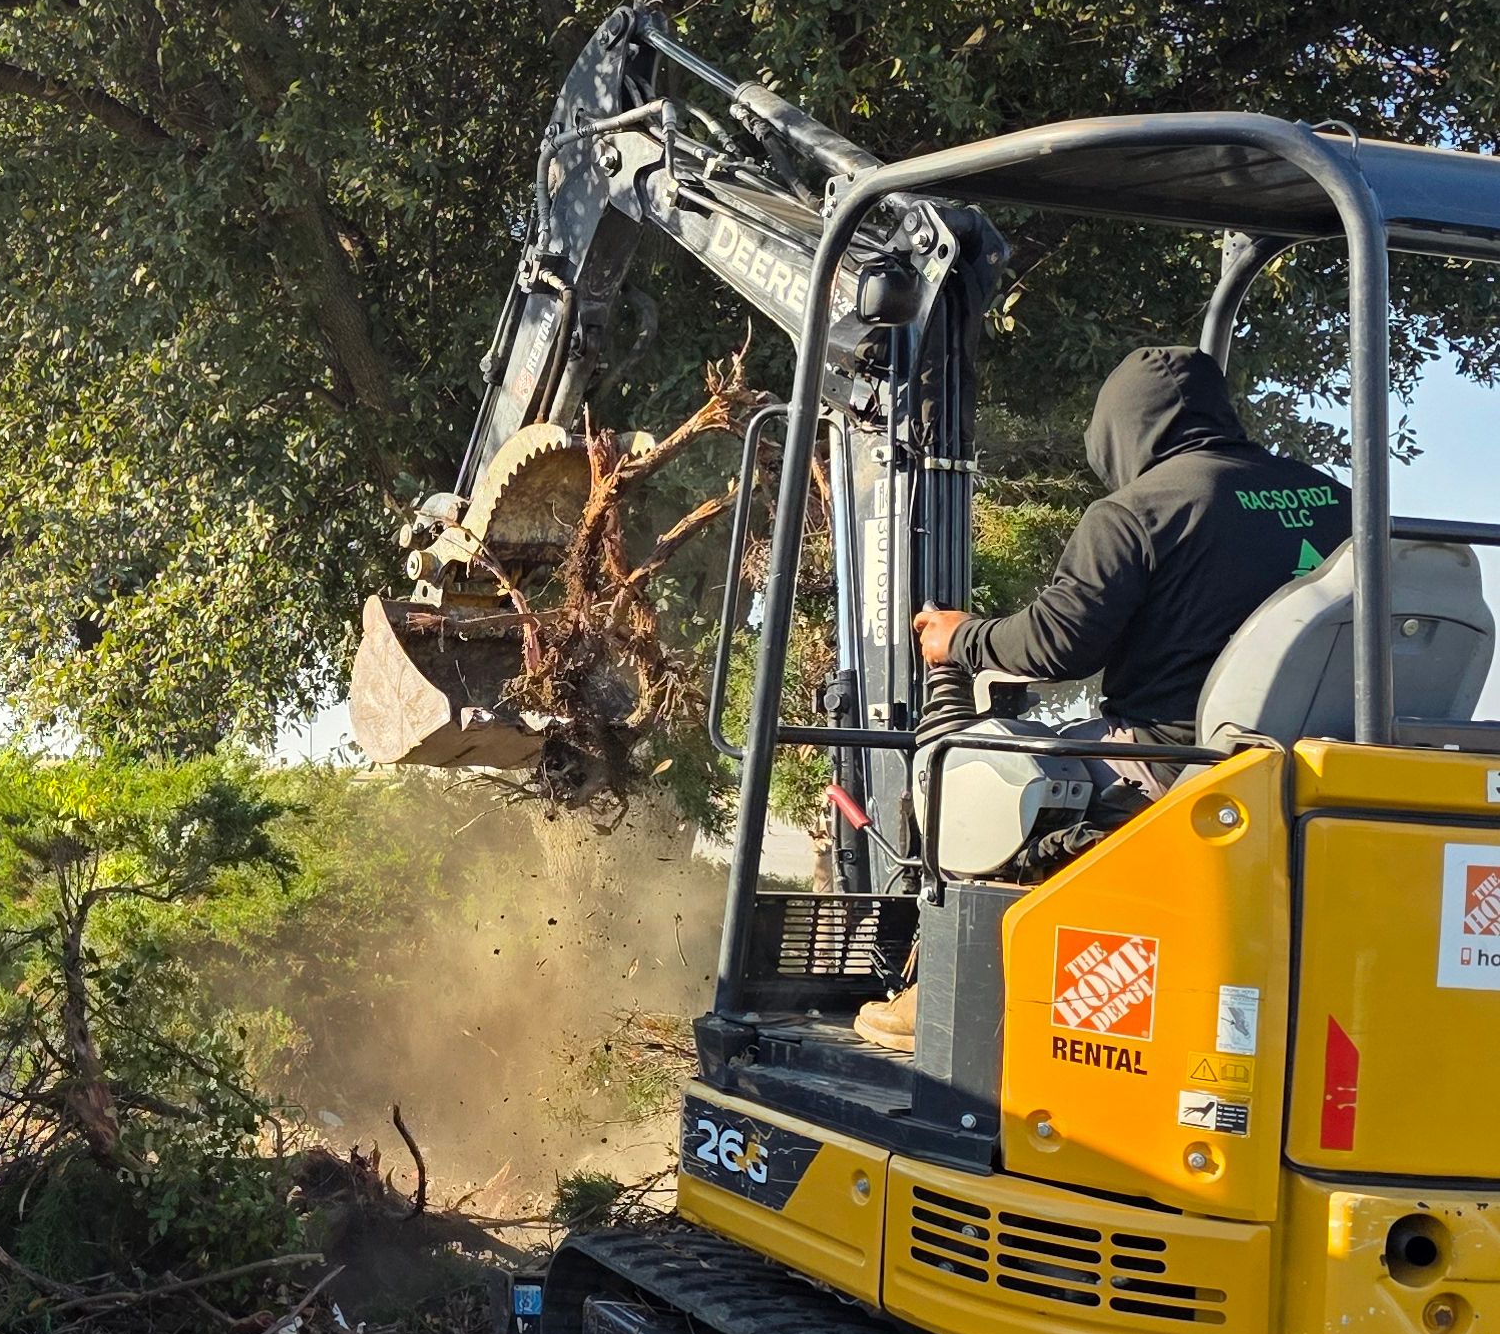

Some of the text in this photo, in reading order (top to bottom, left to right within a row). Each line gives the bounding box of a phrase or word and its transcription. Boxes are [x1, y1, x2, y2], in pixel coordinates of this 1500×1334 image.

[710, 215, 810, 315] DEERE
[525, 311, 556, 374] RENTAL
[1234, 485, 1339, 510] RACSO RDZ
[1278, 509, 1314, 528] LLC
[1471, 872, 1500, 902] THE
[1053, 936, 1157, 1028] HOME
[1063, 940, 1108, 980] THE
[1089, 974, 1154, 1033] DEPOT
[1051, 1035, 1149, 1076] RENTAL
[696, 1118, 769, 1185] 26G
